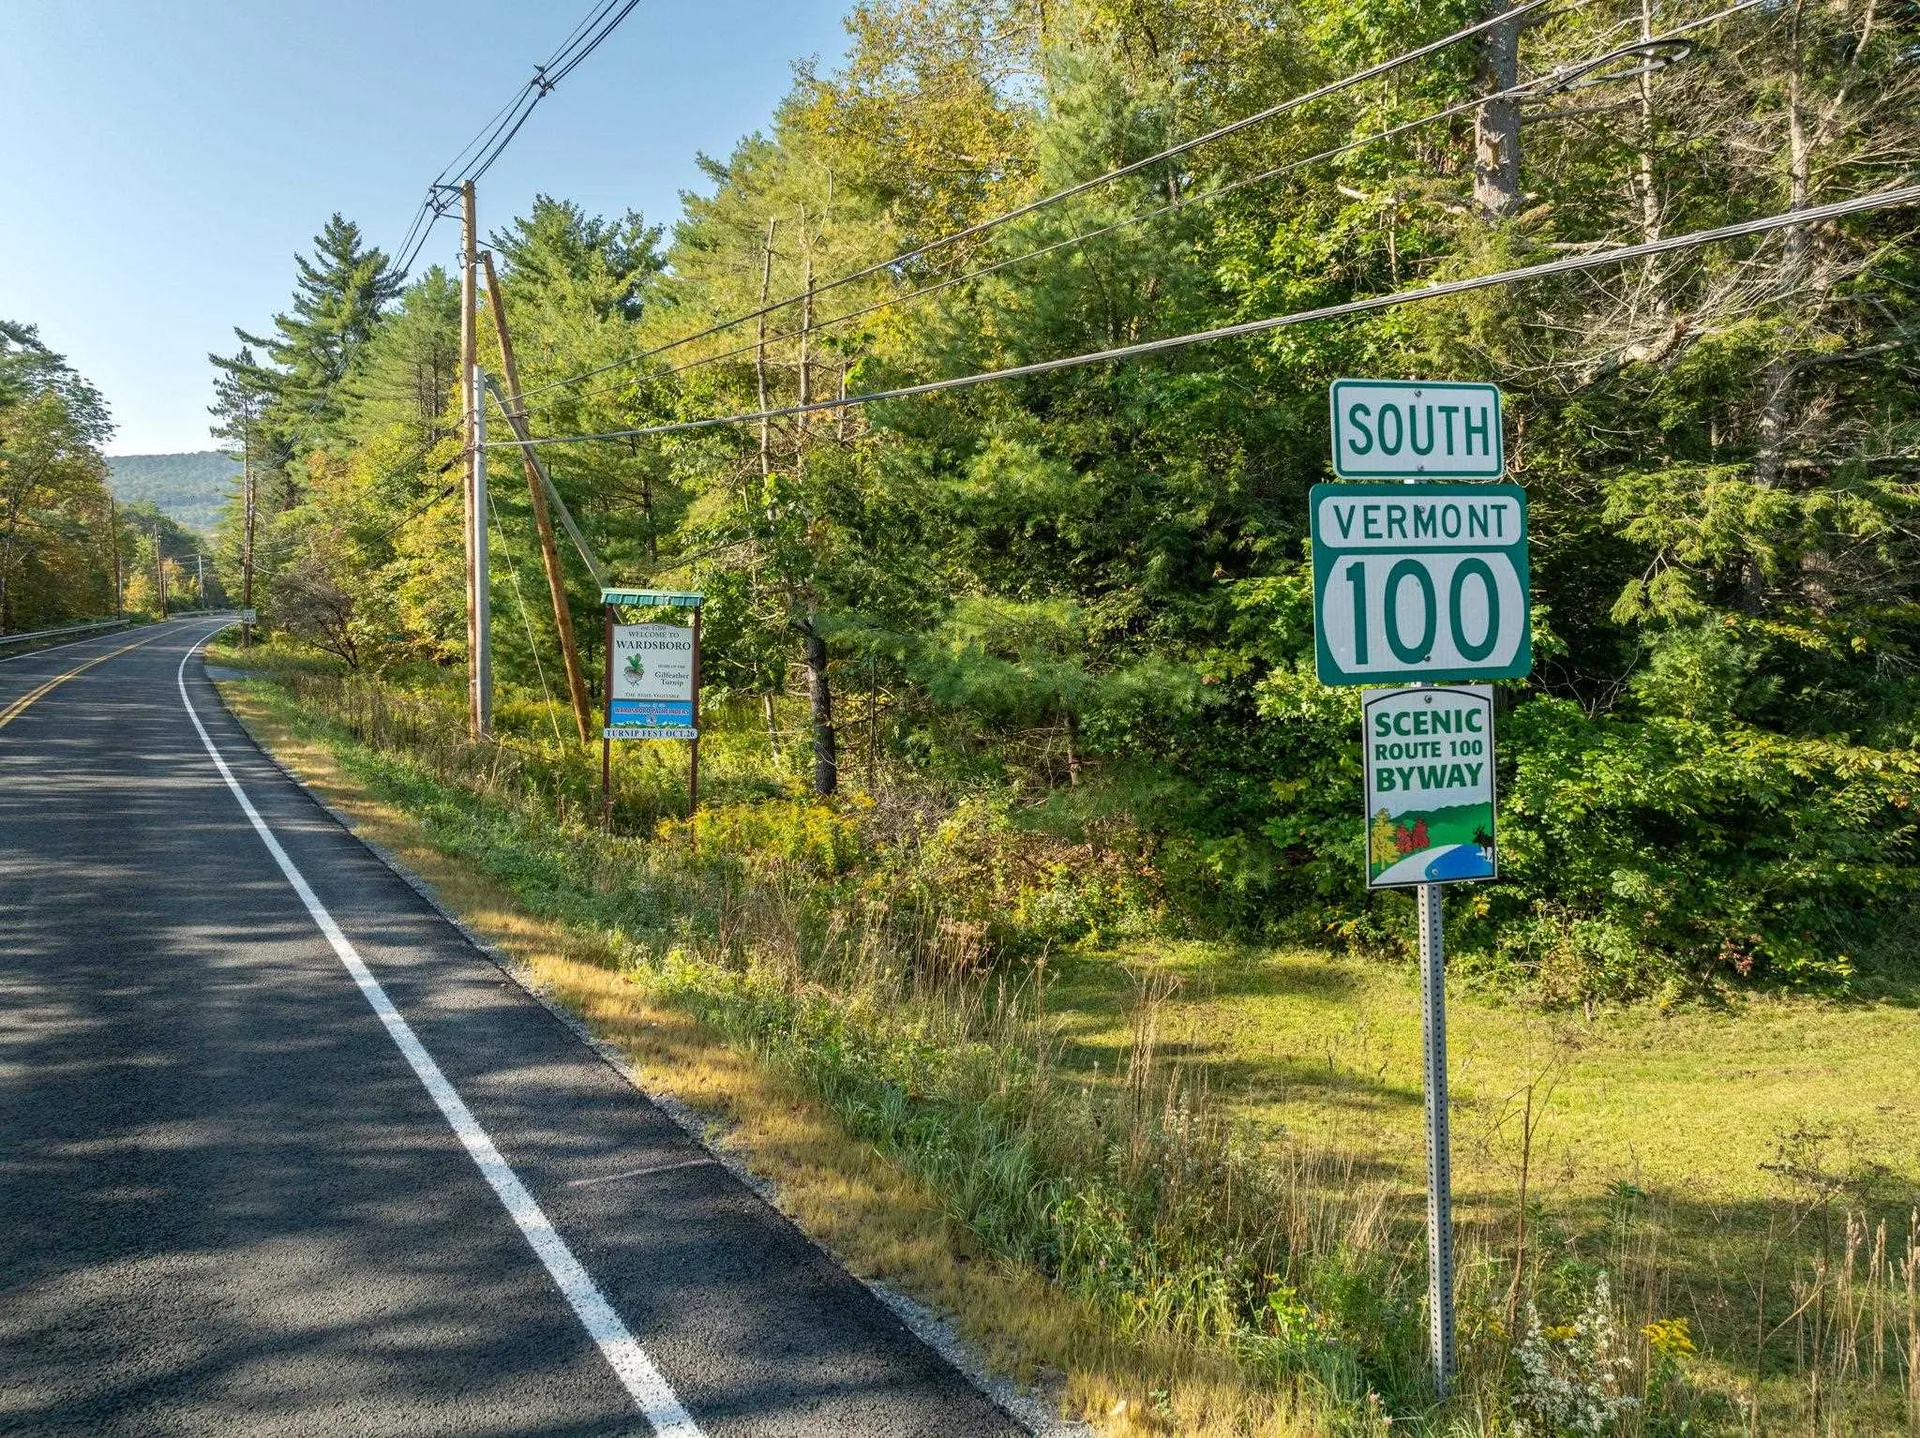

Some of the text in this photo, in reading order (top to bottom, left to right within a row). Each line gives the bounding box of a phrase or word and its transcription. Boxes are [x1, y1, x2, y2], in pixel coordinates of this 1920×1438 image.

[1348, 402, 1490, 456] SOUTH
[1333, 503, 1508, 539] VERMONT
[1345, 557, 1500, 665] 100
[616, 639, 691, 650] WARDSBORO
[628, 631, 666, 639] WELCOME
[654, 670, 689, 680] Gilfeather
[661, 678, 684, 687] Turnip
[606, 729, 640, 737] TURNIP
[642, 729, 662, 738] FEST
[1374, 708, 1483, 738] SCENIC
[1375, 739, 1483, 761] ROUTE 100
[1376, 762, 1484, 792] BYWAY
